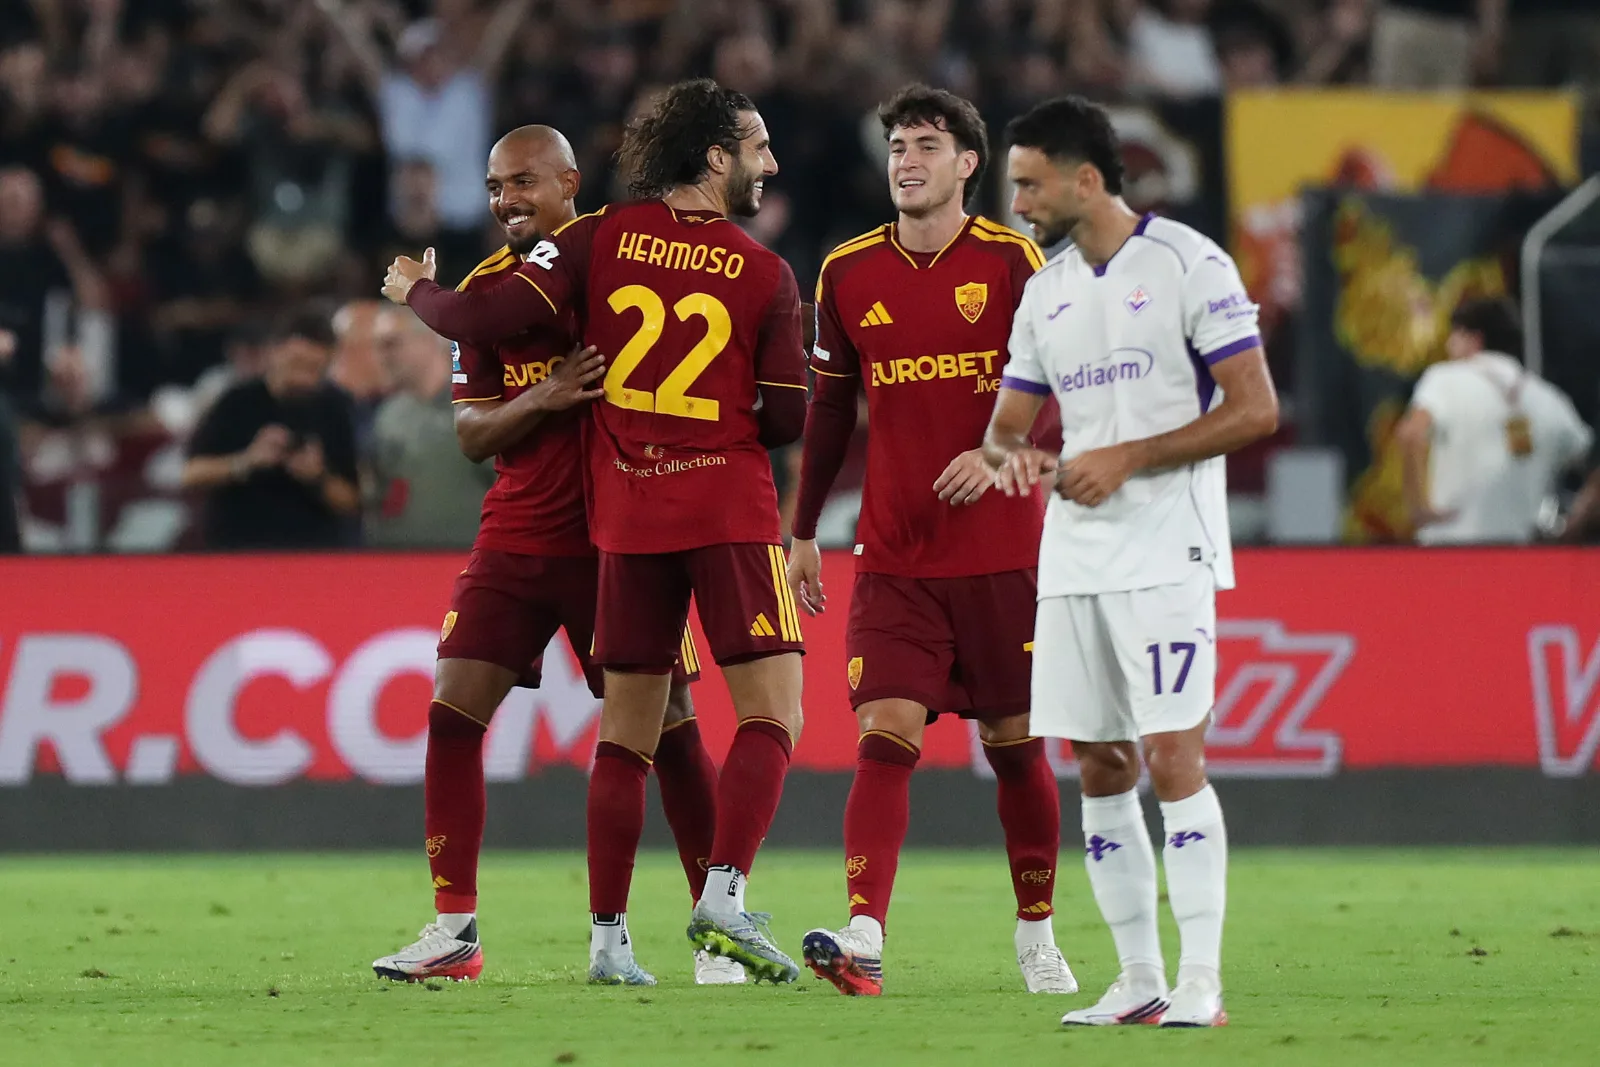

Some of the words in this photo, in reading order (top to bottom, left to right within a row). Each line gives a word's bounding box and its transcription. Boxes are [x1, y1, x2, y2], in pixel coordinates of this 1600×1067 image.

[616, 231, 745, 279] HERMOSO
[602, 284, 732, 421] 22
[871, 350, 999, 387] EUROBET
[1056, 361, 1141, 394] ediaom
[655, 454, 727, 476] Collection
[1146, 642, 1197, 695] 17
